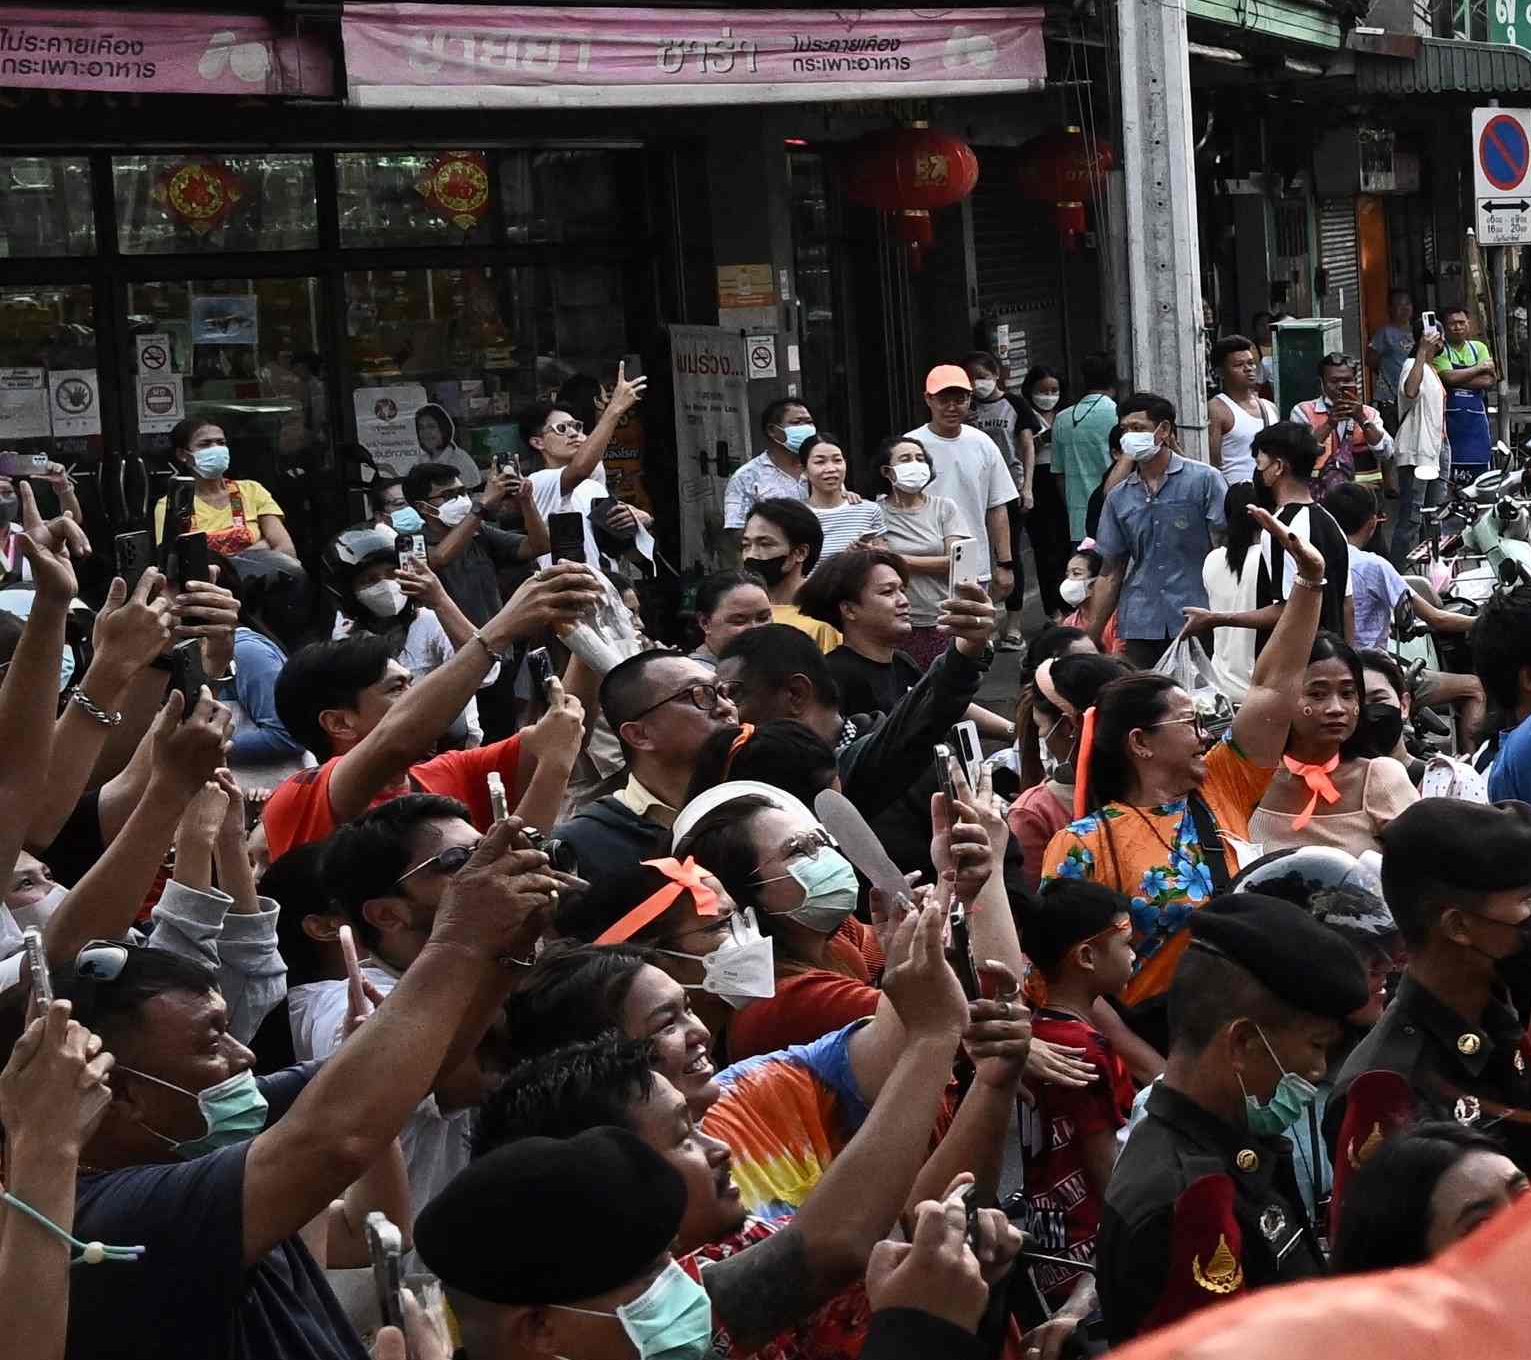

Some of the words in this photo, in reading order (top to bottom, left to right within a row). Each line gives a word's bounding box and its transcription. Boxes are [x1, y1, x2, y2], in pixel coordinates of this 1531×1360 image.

[2, 57, 156, 79] กระเพาะอาหาร
[792, 55, 911, 73] กระเพาะอาหาร
